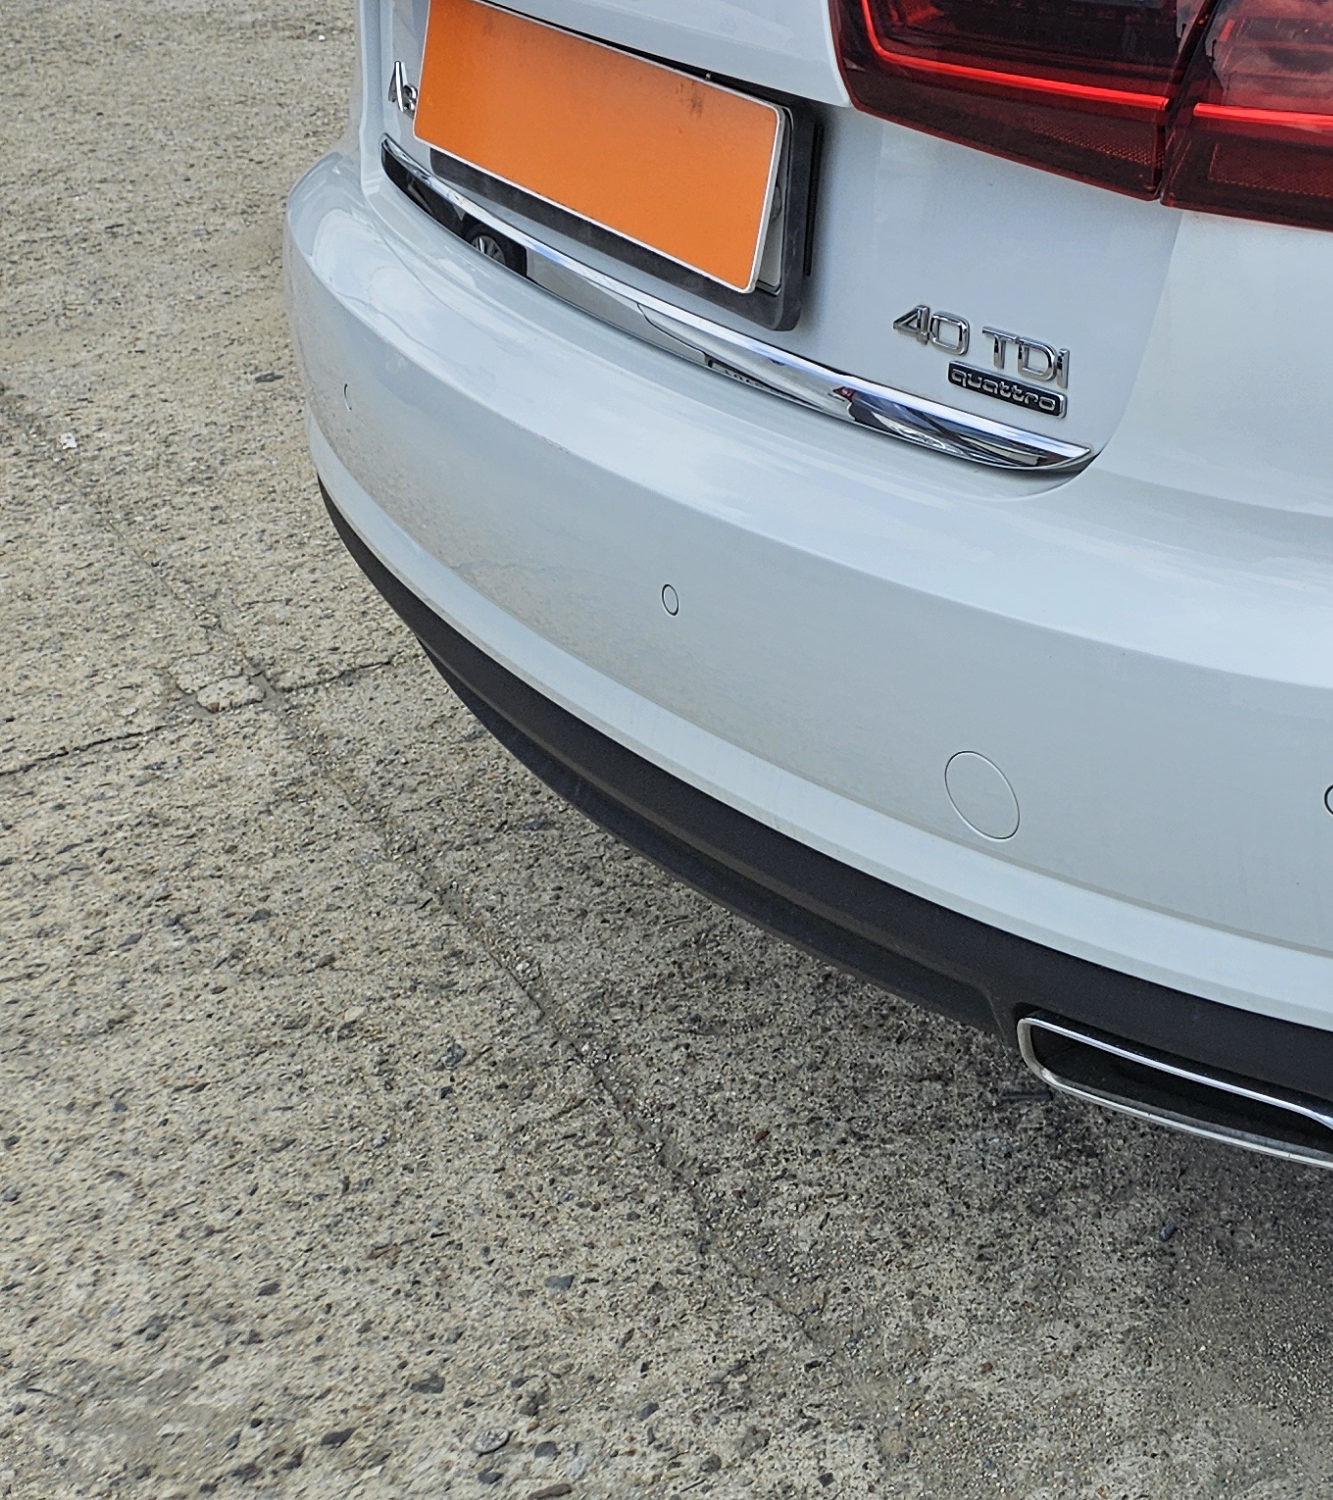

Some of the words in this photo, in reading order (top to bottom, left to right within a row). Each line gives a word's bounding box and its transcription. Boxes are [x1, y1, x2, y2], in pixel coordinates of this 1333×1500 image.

[893, 305, 970, 356] 40
[982, 326, 1070, 389] TDI
[951, 367, 1057, 412] quattro
